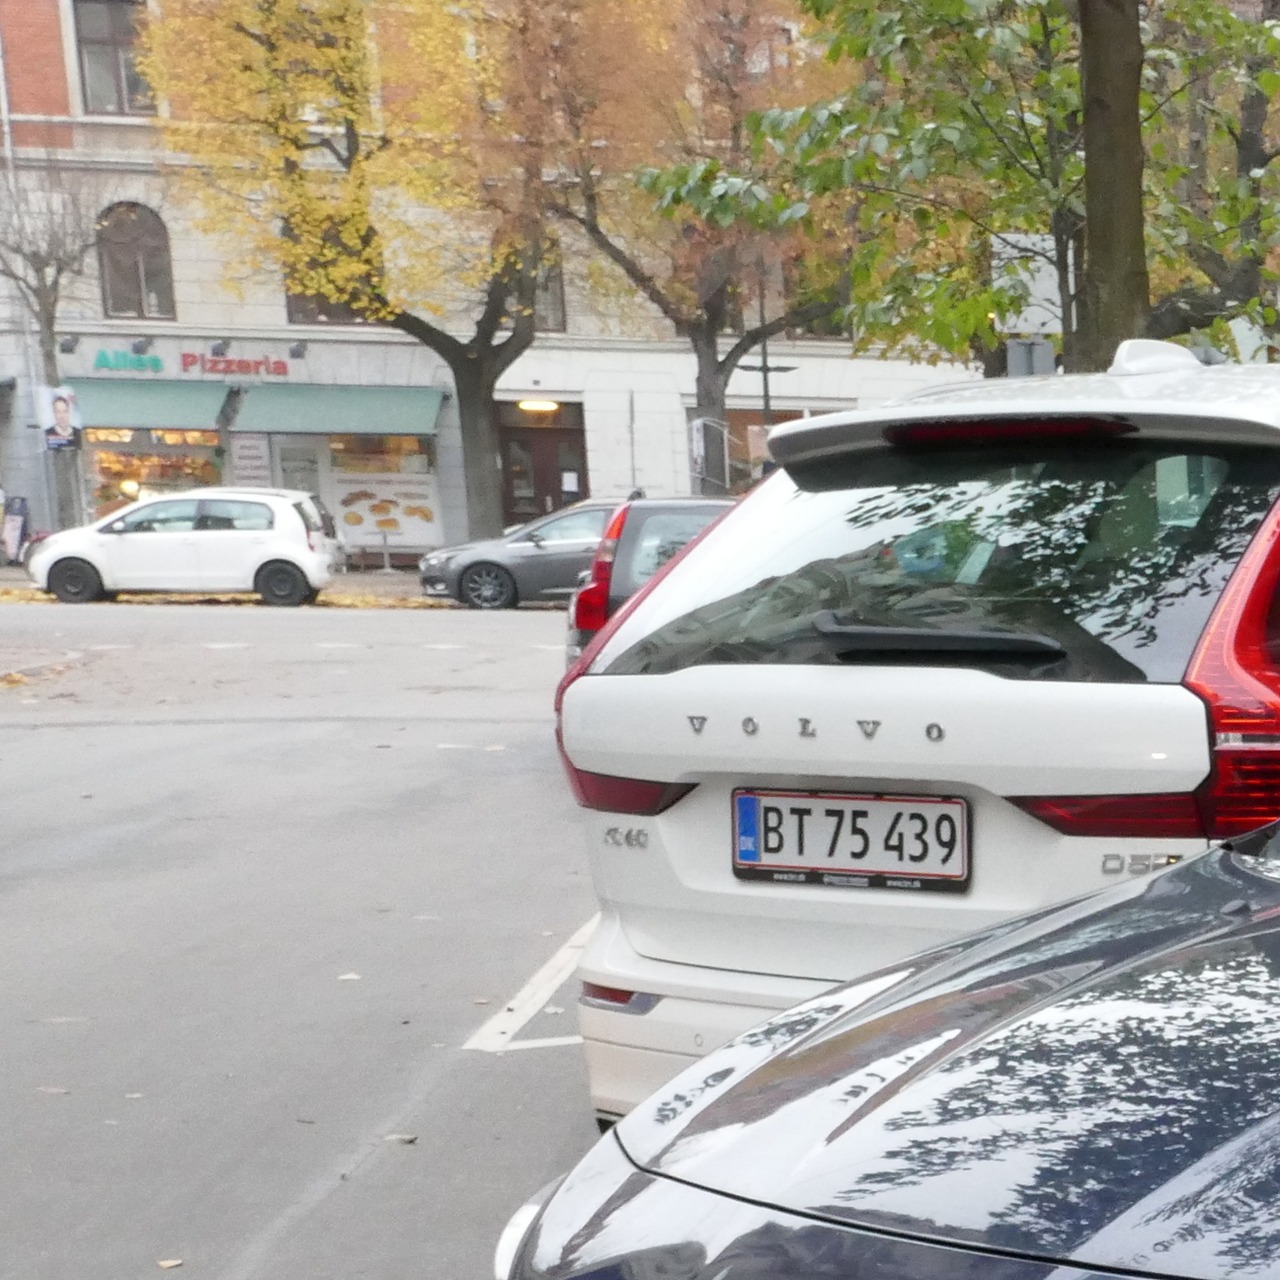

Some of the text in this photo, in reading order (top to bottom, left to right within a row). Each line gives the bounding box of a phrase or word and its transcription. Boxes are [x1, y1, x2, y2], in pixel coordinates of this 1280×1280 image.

[181, 352, 289, 376] Pizzeria
[687, 715, 946, 743] VOLVO
[763, 806, 957, 865] BT 75 439
